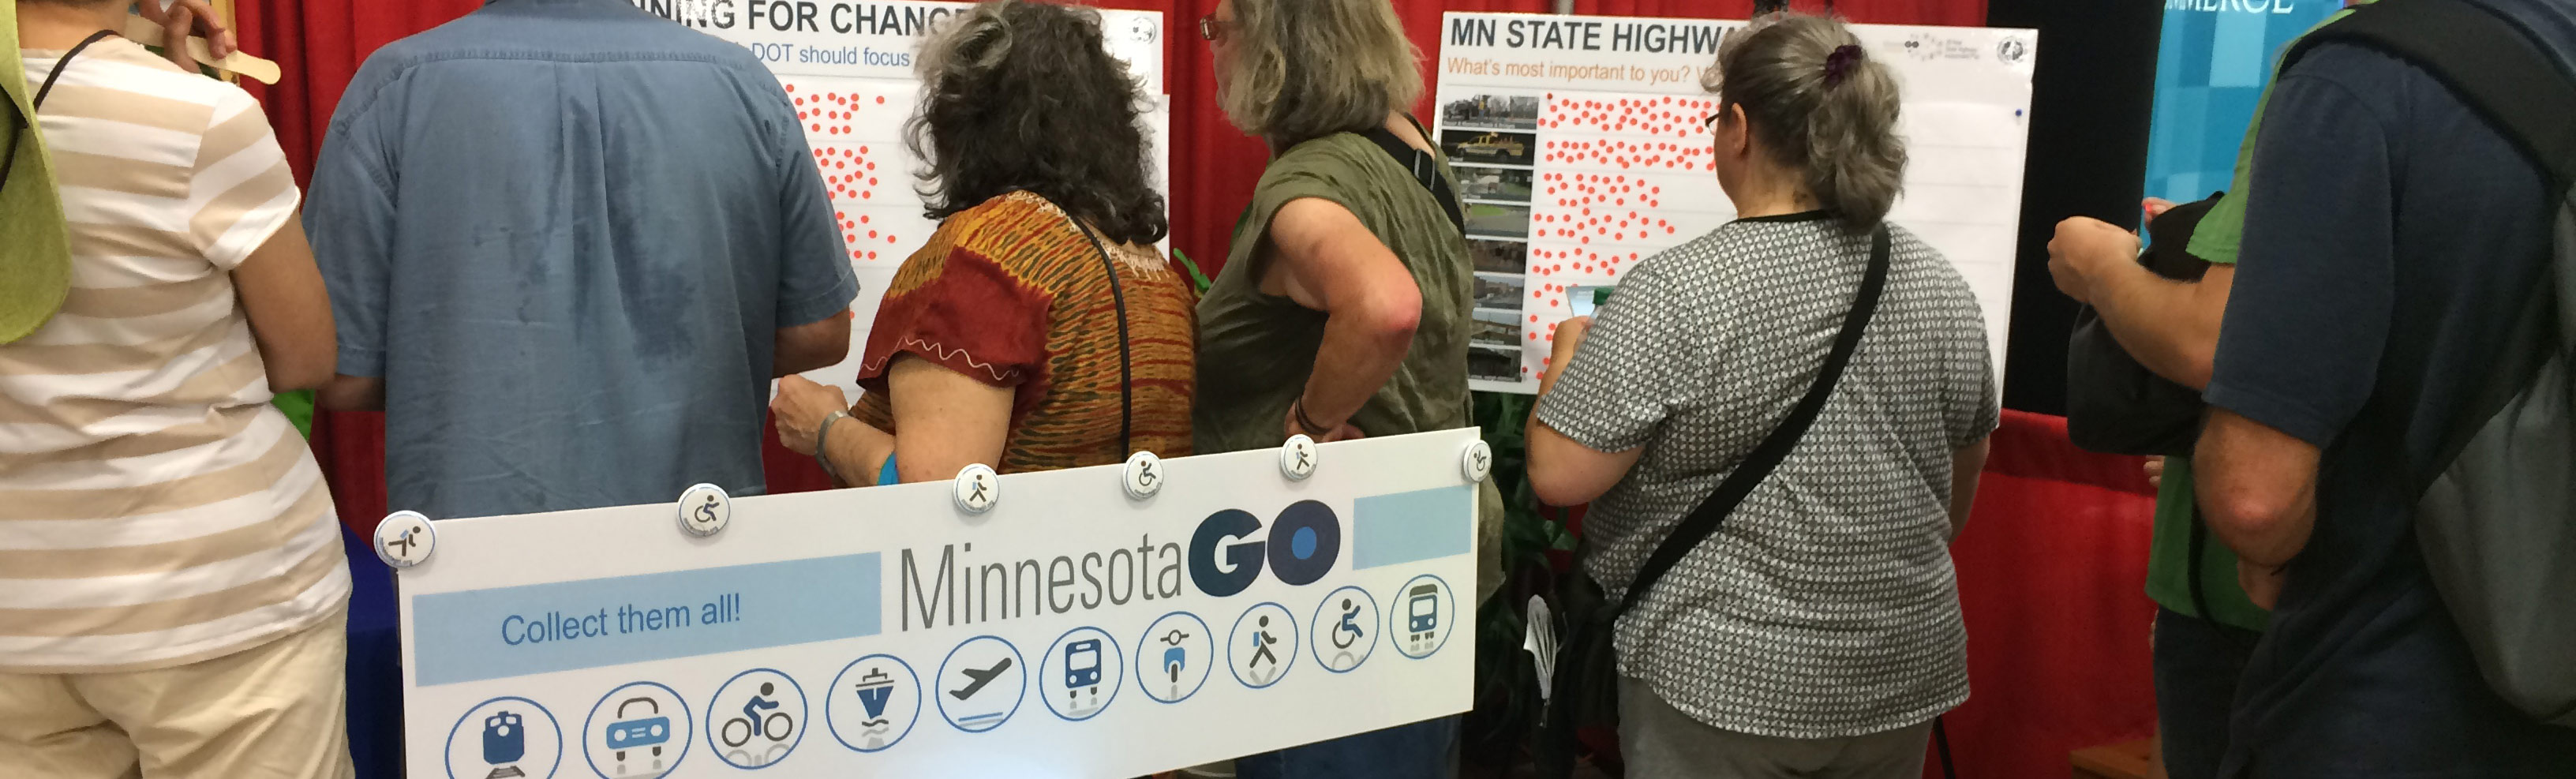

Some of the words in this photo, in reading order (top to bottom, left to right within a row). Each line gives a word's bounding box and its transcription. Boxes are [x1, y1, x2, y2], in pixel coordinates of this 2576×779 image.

[748, 0, 819, 32] FOR
[830, 2, 971, 36] CHANG
[1451, 18, 1496, 47] MN
[1506, 19, 1602, 51] STATE
[1612, 23, 1734, 55] HIGHW
[799, 46, 857, 65] should
[863, 47, 910, 67] focus
[1447, 57, 1500, 76] What's
[1505, 62, 1544, 77] most
[1548, 61, 1625, 82] important
[1631, 65, 1646, 81] to
[1650, 66, 1690, 86] you?
[502, 607, 608, 646] Collect
[617, 603, 691, 635] them
[701, 592, 740, 625] all!
